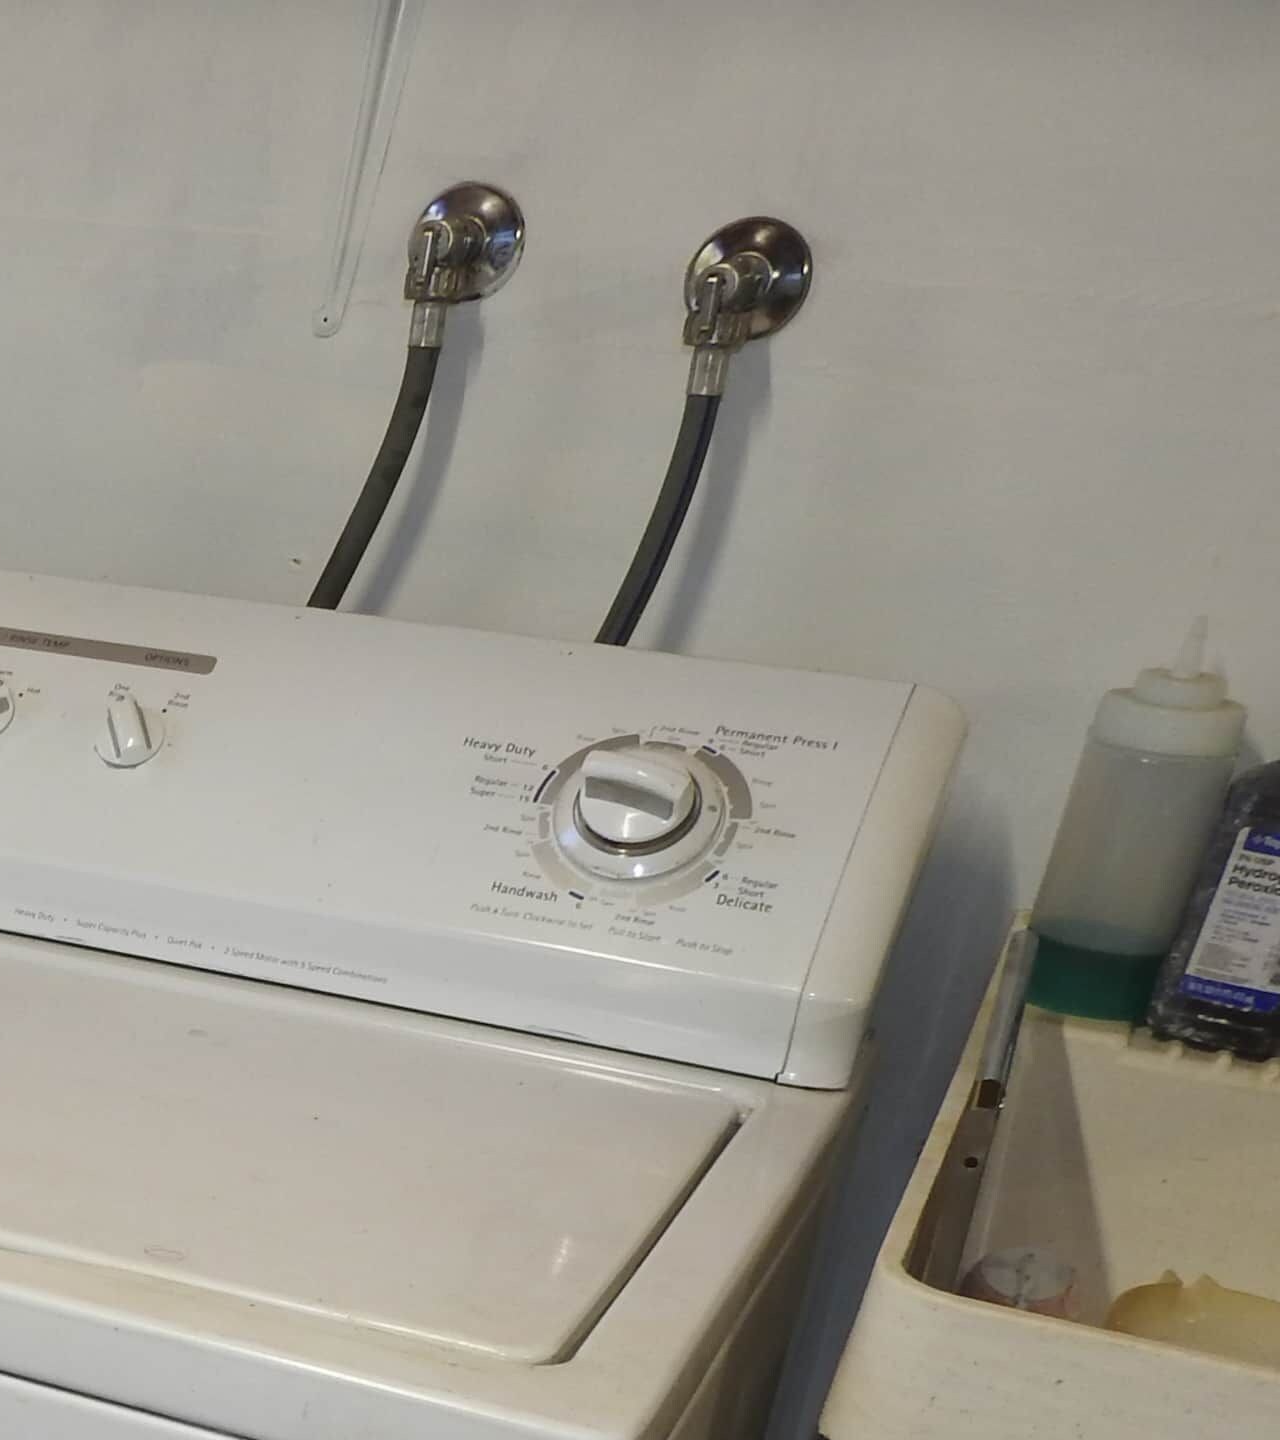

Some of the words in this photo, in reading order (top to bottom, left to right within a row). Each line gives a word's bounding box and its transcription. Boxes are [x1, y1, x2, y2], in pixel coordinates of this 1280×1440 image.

[144, 652, 190, 666] OPTIONS
[463, 736, 502, 753] Heavy
[505, 742, 536, 758] Duty
[715, 725, 789, 744] Permanent
[792, 735, 828, 750] Press
[474, 775, 508, 787] Regular
[1232, 863, 1280, 883] Hydro
[490, 881, 558, 902] Handwash
[716, 893, 773, 913] Delicate
